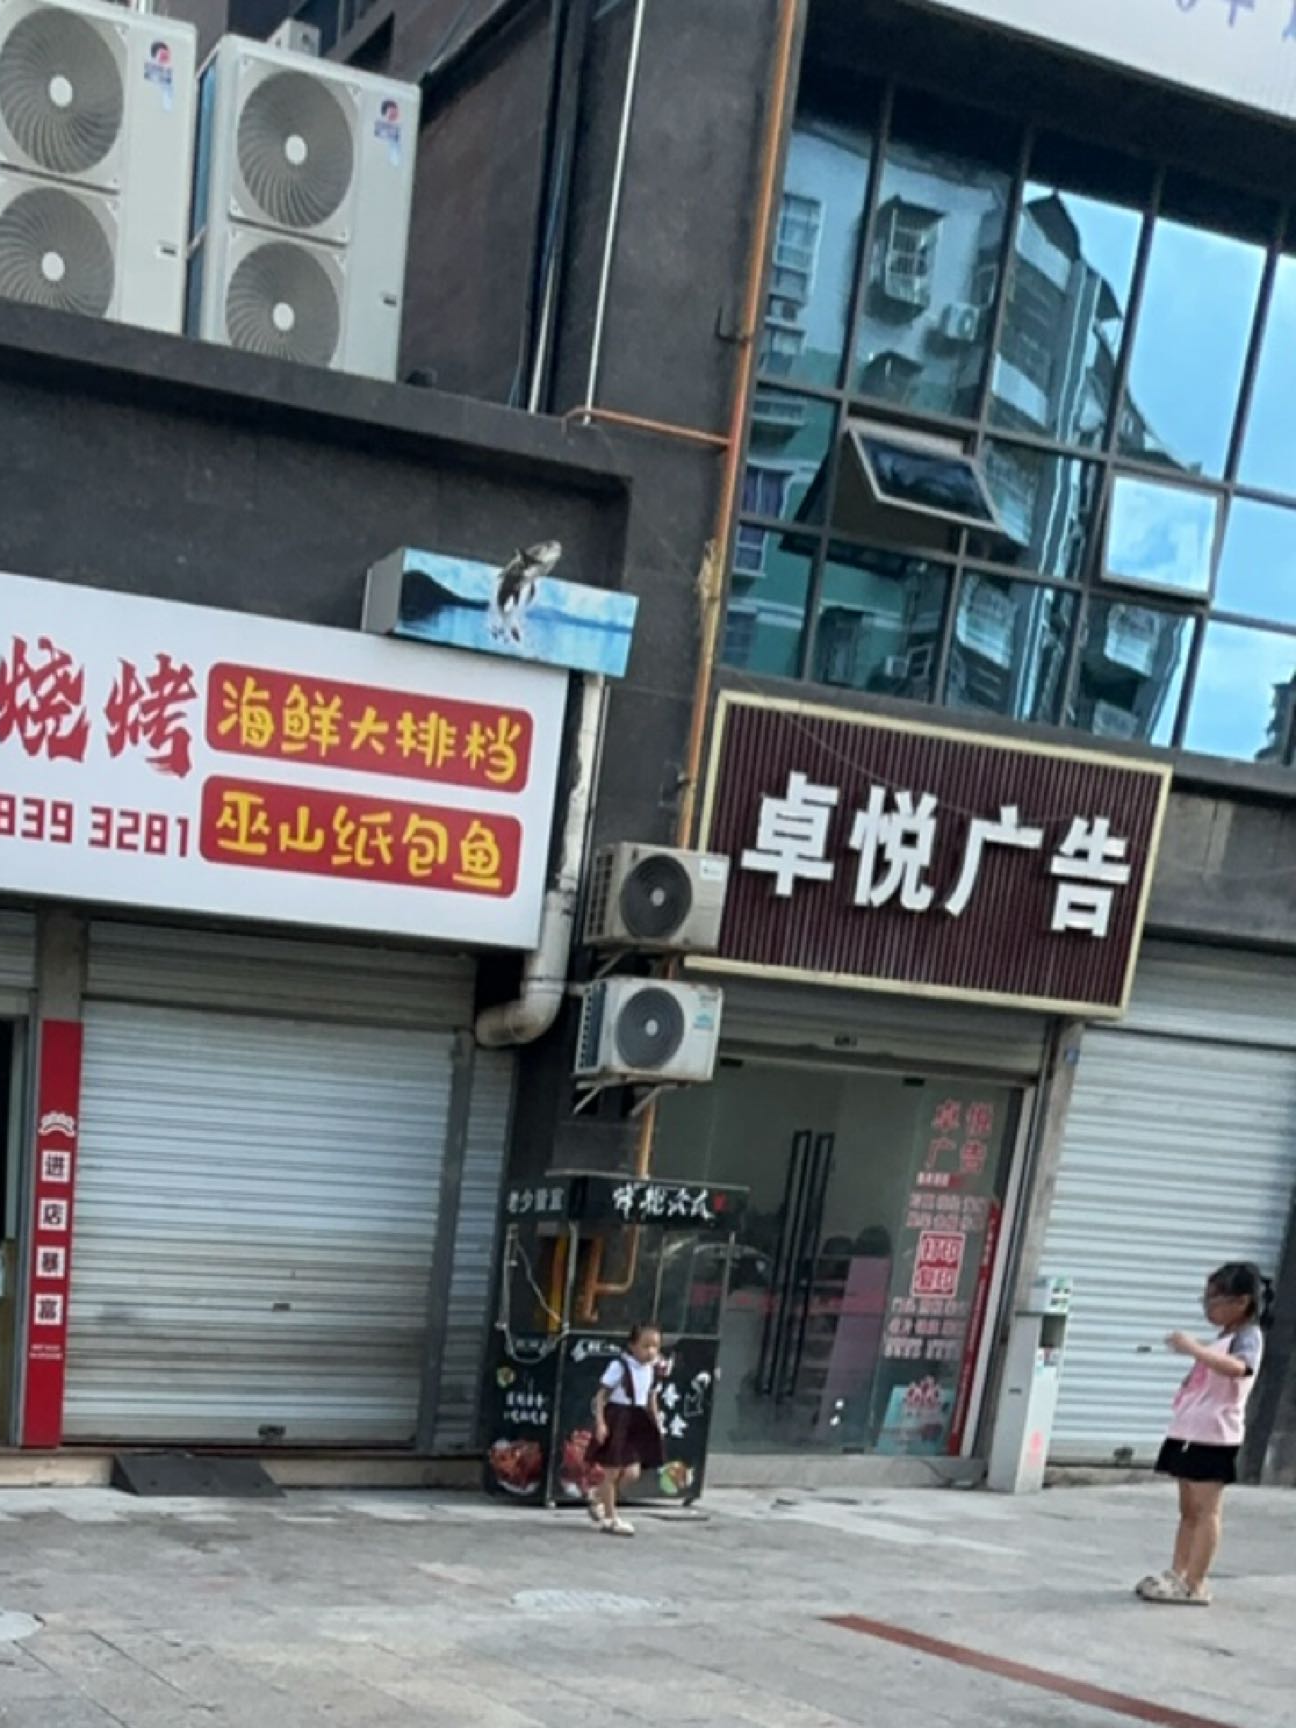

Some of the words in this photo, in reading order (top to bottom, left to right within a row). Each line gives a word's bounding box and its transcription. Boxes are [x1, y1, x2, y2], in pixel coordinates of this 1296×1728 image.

[217, 675, 521, 783] 海鲜大排档
[88, 806, 190, 858] 3281
[215, 790, 502, 888] 巫山纸包鱼
[740, 771, 1132, 939] 卓悦广告
